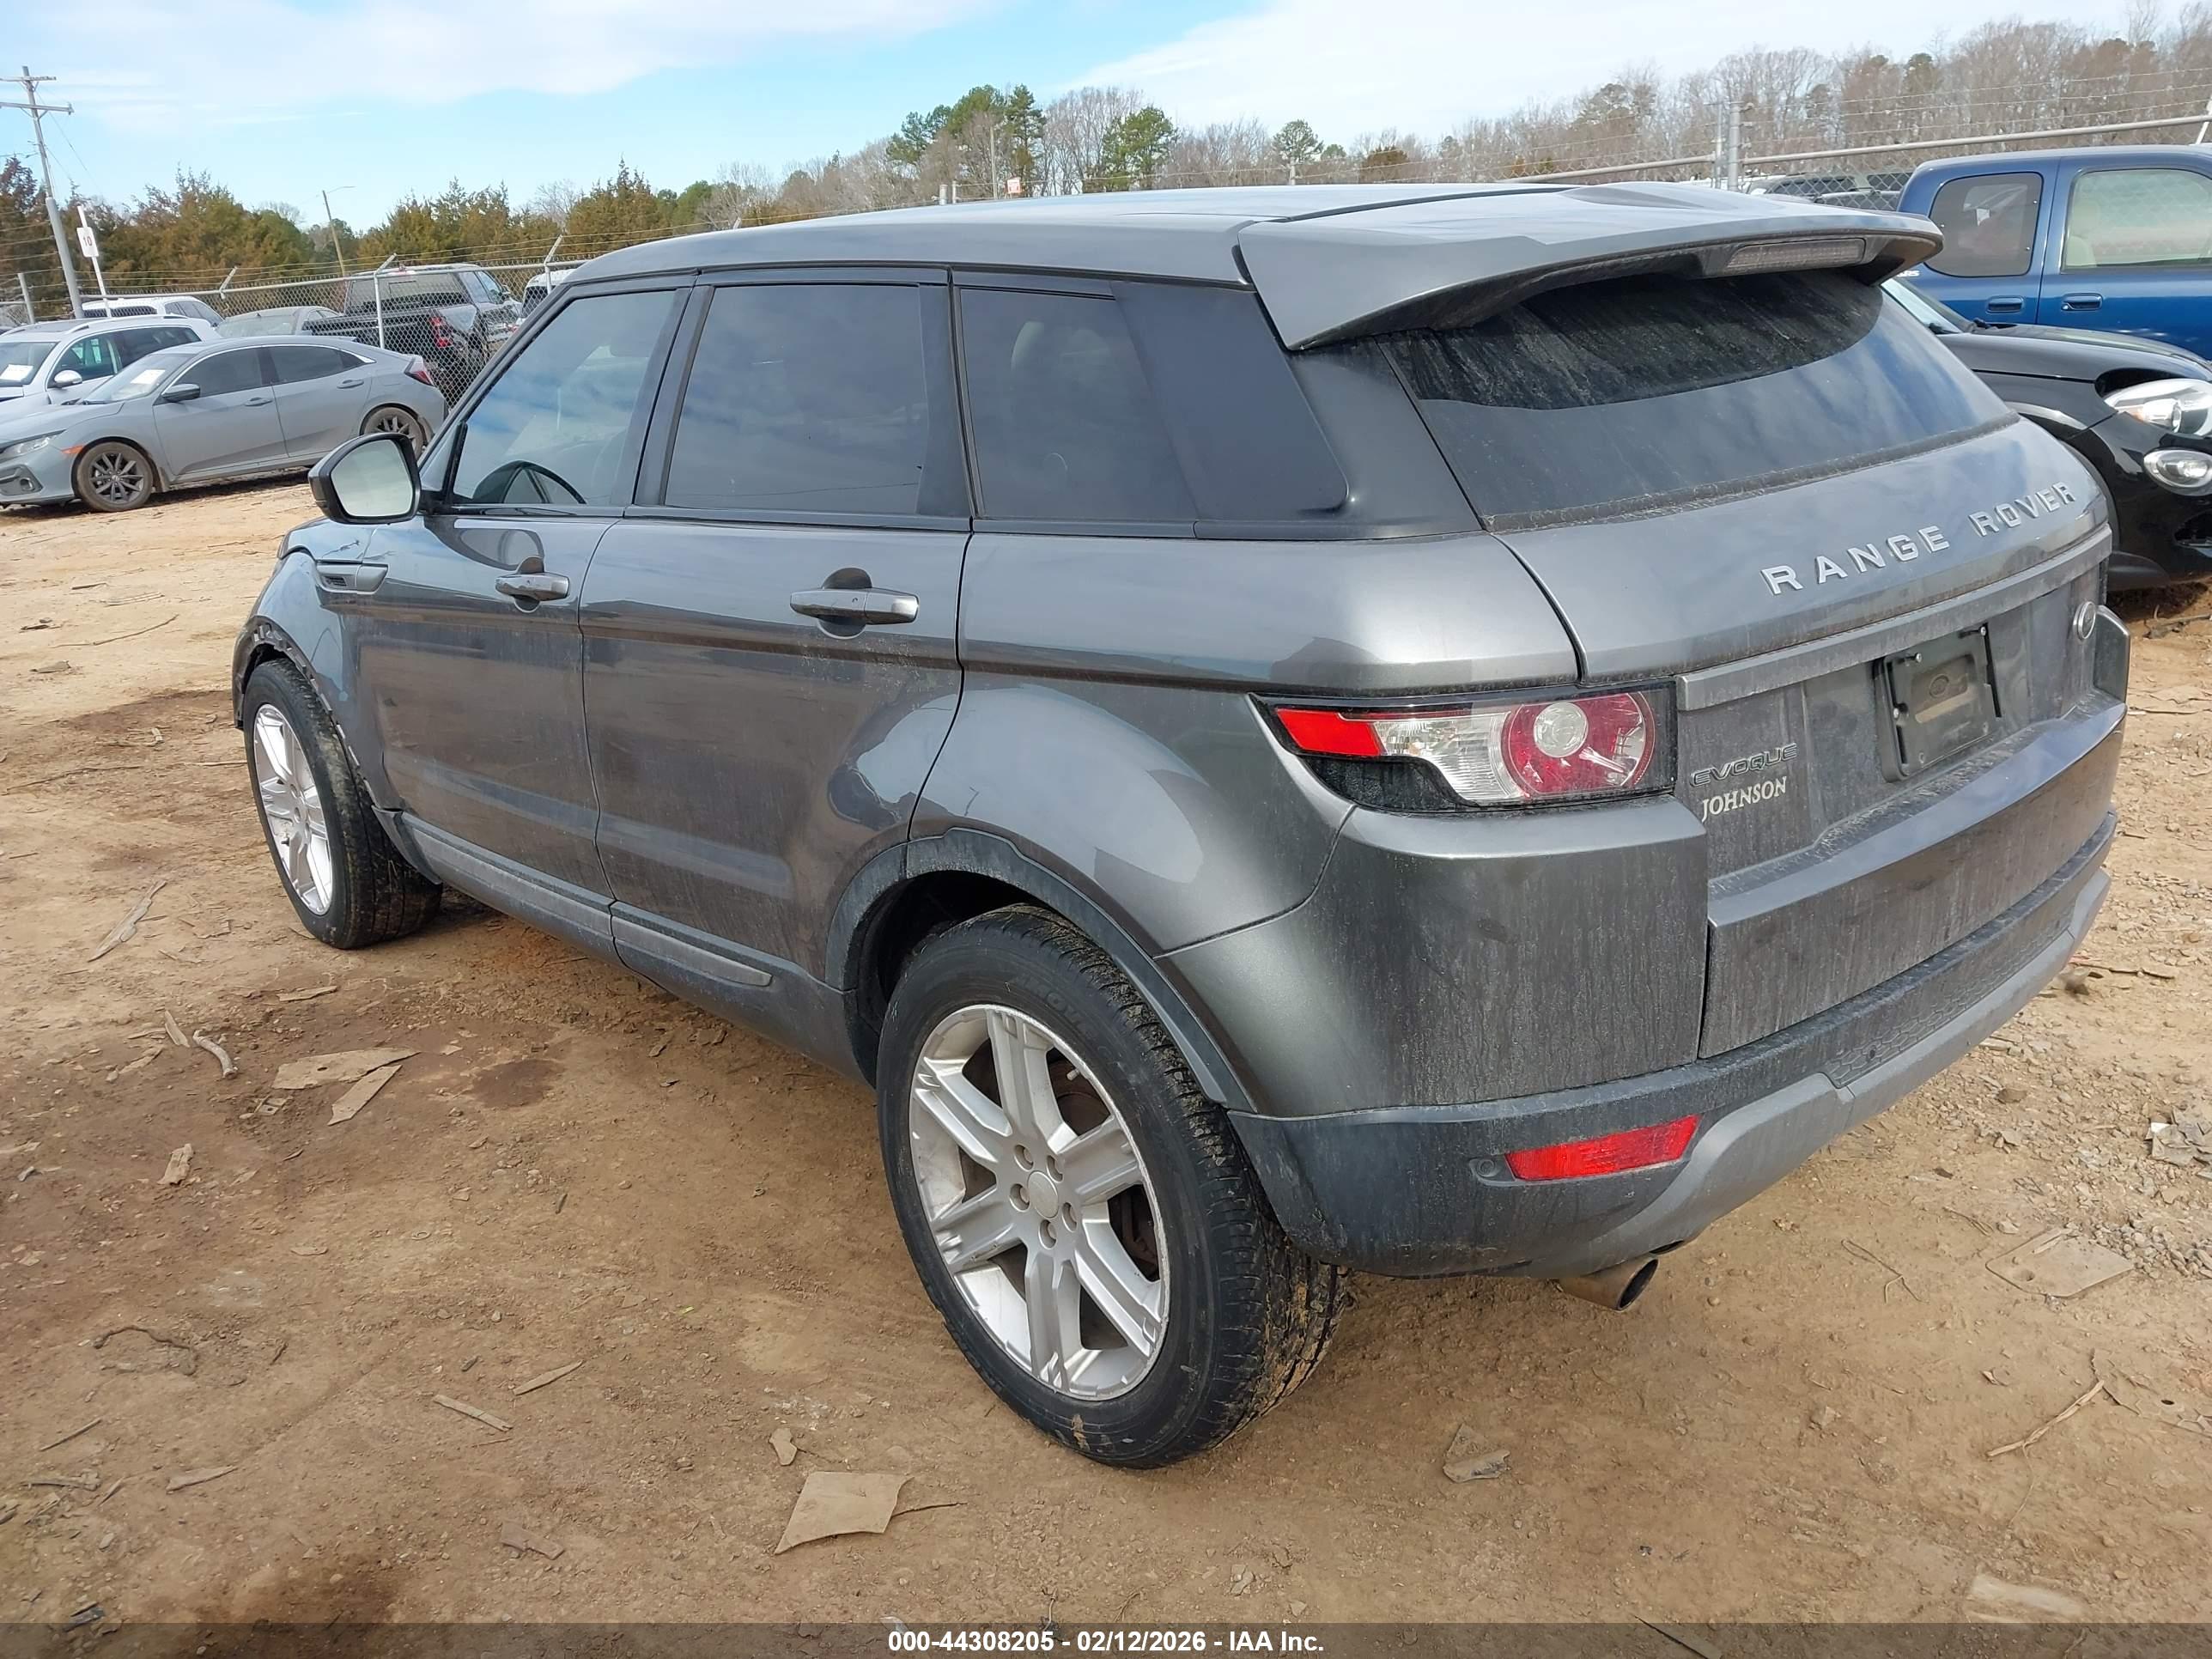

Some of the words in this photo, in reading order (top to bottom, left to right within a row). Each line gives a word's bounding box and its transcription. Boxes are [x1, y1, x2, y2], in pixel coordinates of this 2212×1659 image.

[83, 236, 92, 246] 10
[1760, 526, 1950, 595] RANGE
[1968, 482, 2076, 537] ROVER
[1691, 742, 1797, 787] EVOQUE
[1702, 776, 1787, 823] JOHNSON
